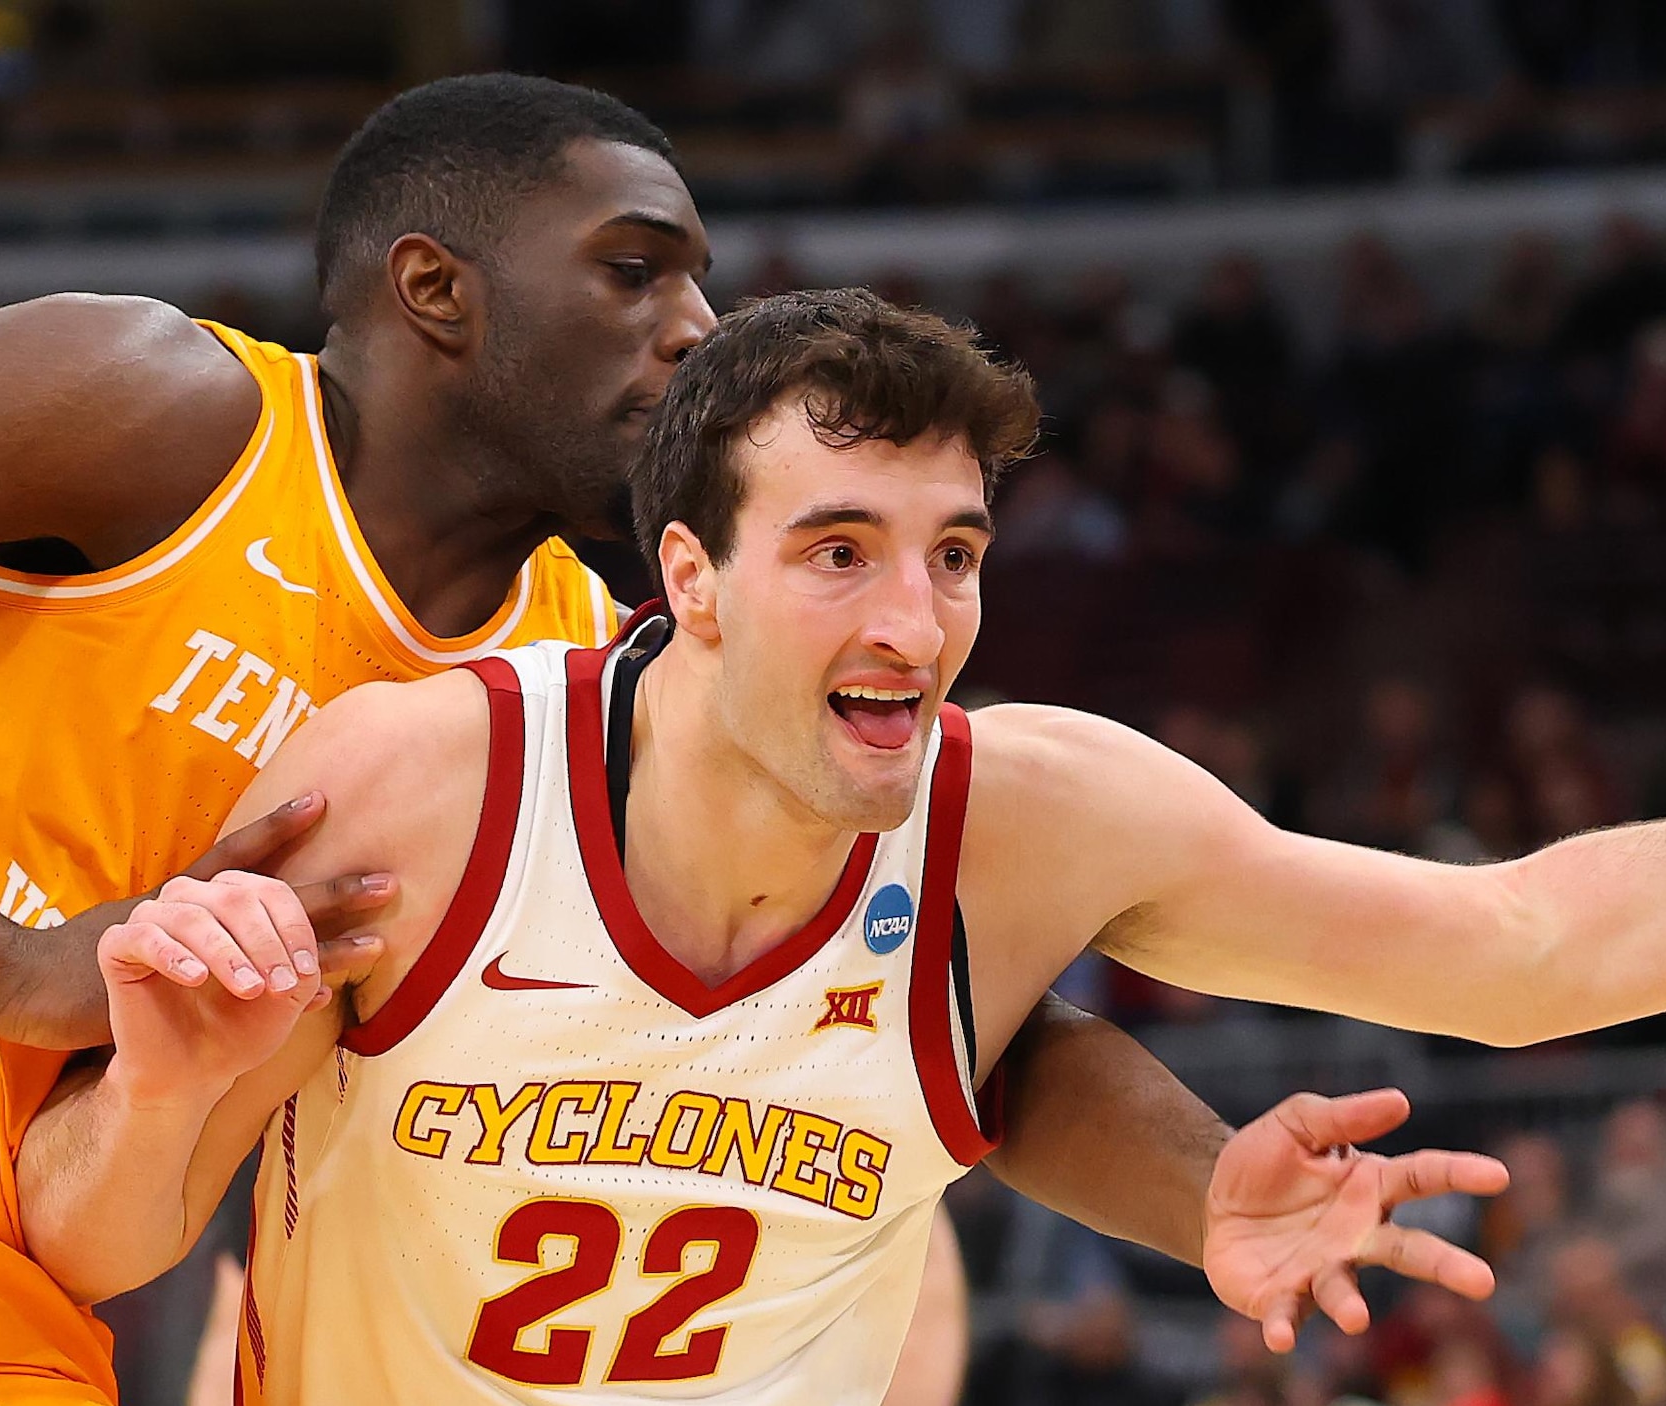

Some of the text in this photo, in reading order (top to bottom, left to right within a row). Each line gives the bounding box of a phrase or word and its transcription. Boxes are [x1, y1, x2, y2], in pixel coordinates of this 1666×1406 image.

[149, 628, 320, 770] TEN
[869, 915, 910, 938] NCAA
[808, 979, 885, 1035] XII
[393, 1080, 892, 1220] CYCLONES
[464, 1195, 763, 1388] 22
